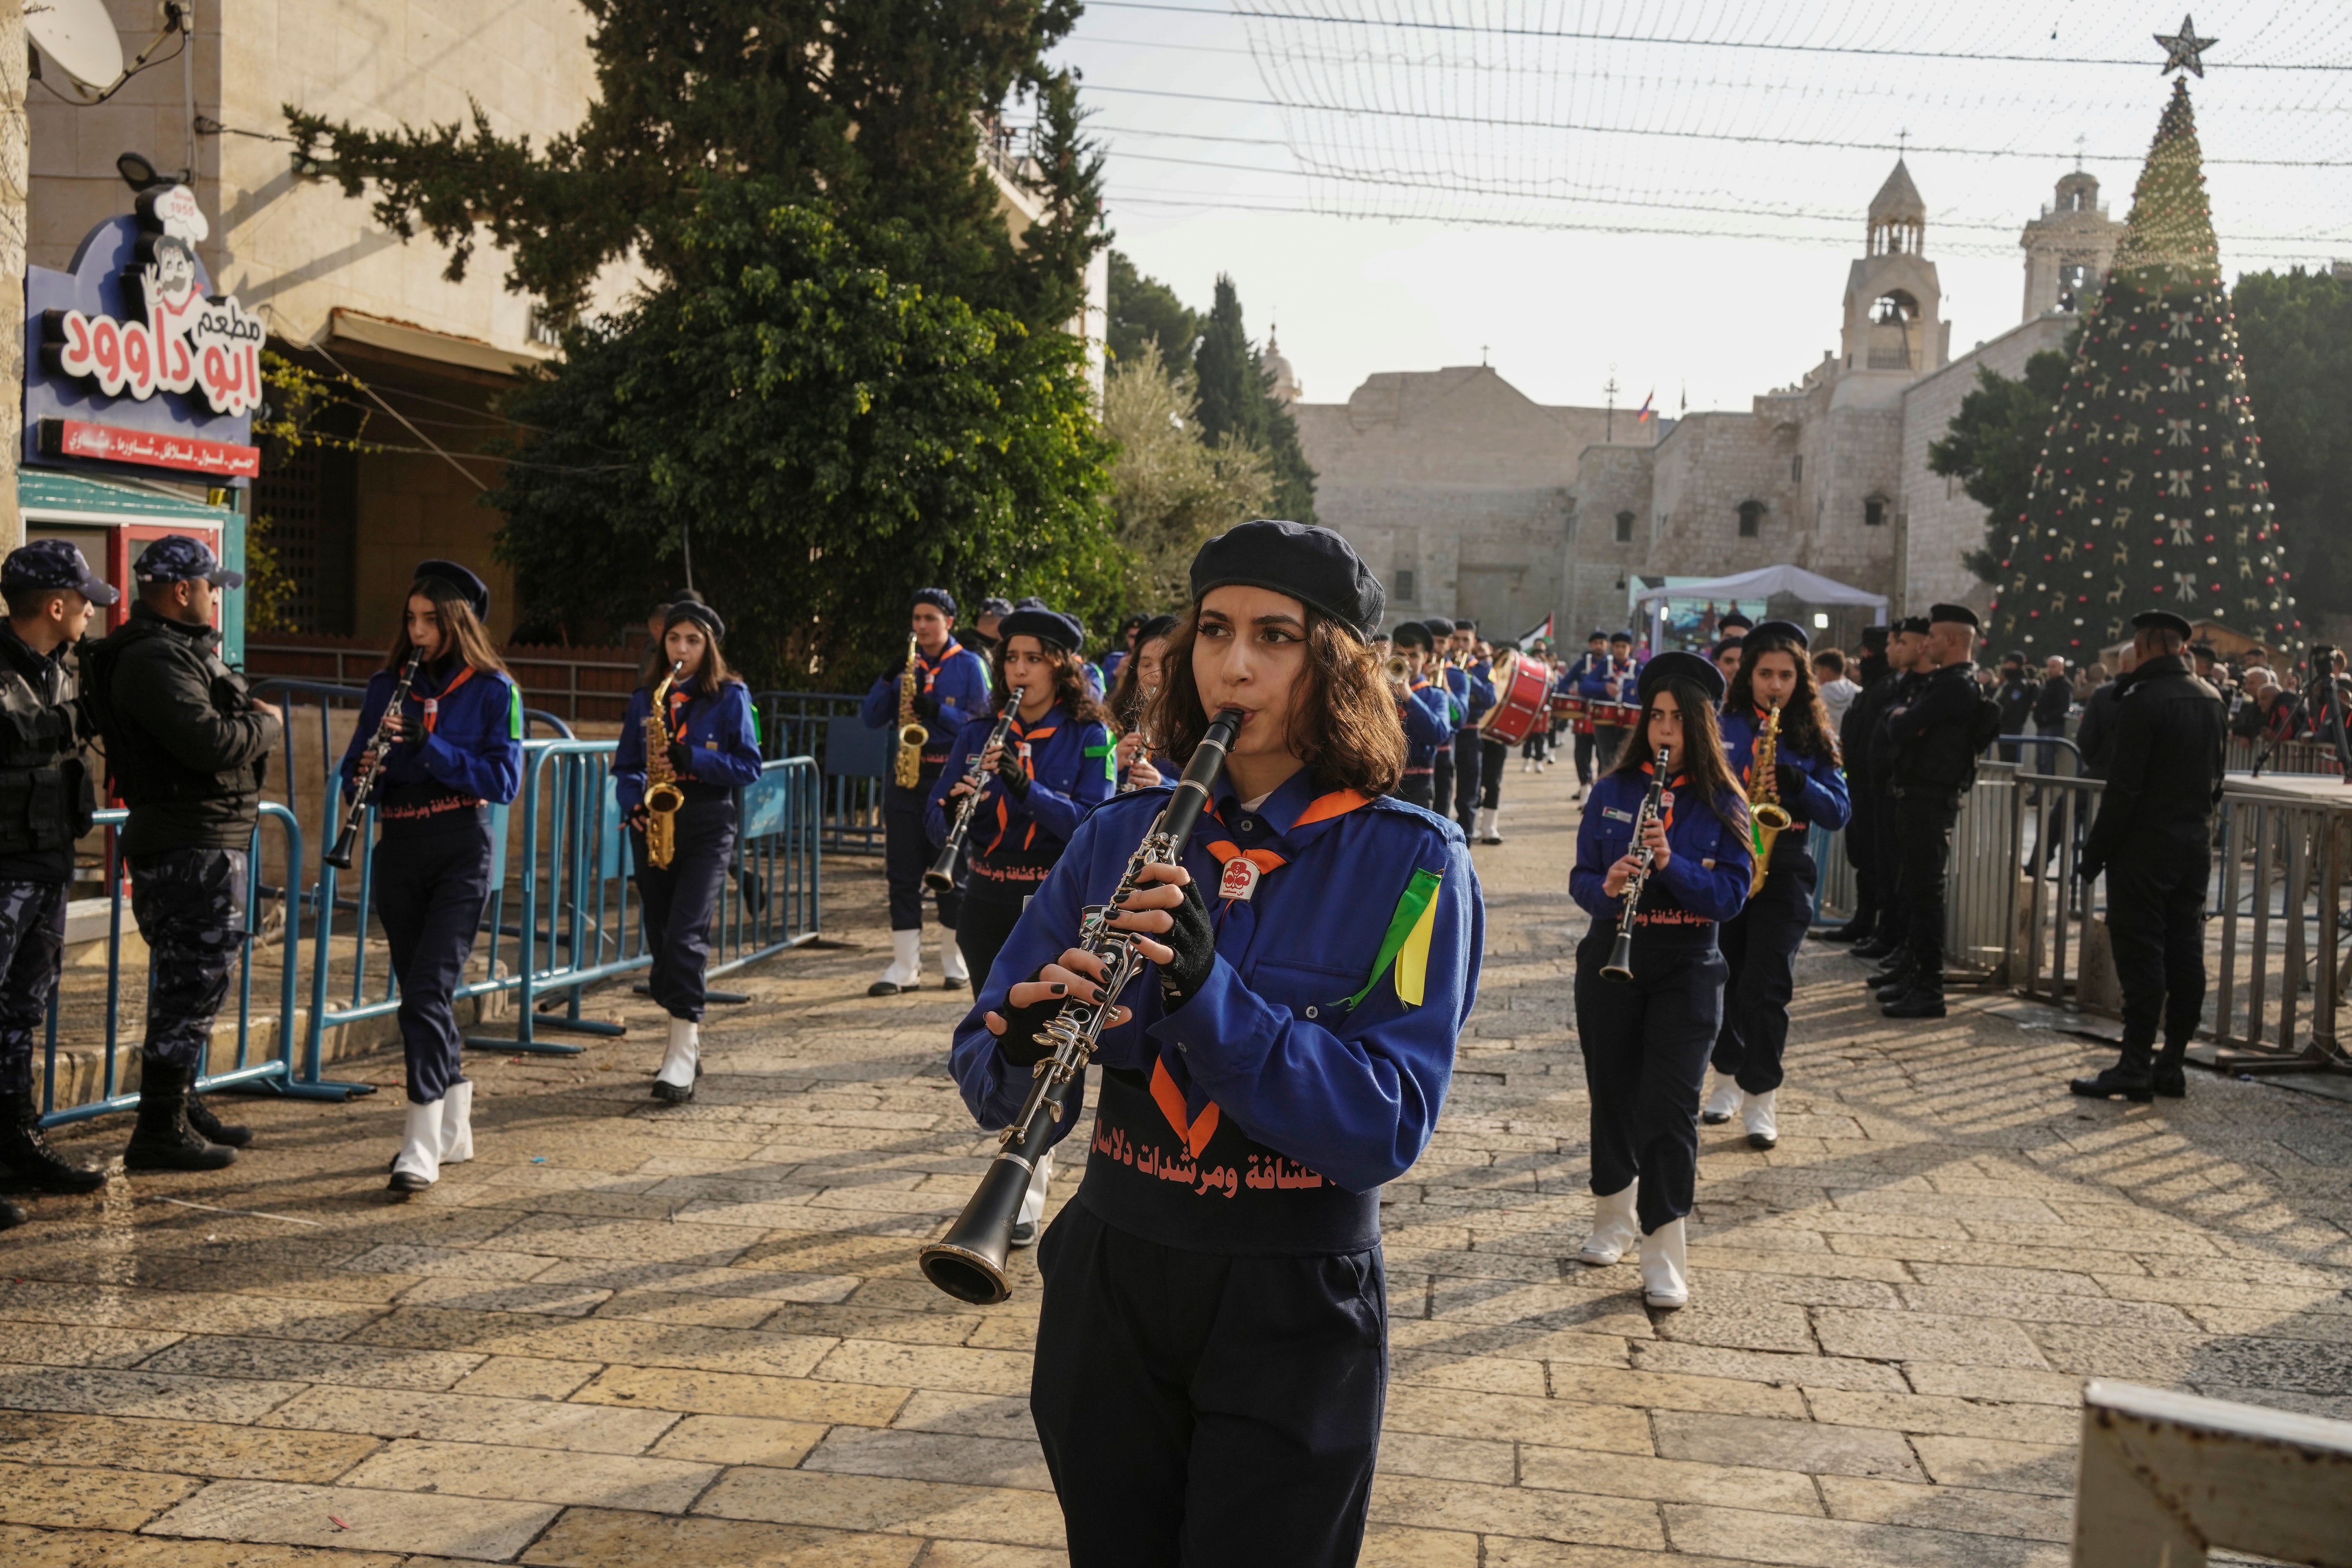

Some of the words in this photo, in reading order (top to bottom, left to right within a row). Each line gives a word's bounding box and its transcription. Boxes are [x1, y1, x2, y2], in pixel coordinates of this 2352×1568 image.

[69, 307, 190, 388] داوود
[198, 305, 260, 341] مطعم
[204, 345, 256, 406] ابو
[1092, 1117, 1133, 1166] دلاسال
[1137, 1146, 1238, 1198] ومرشدات
